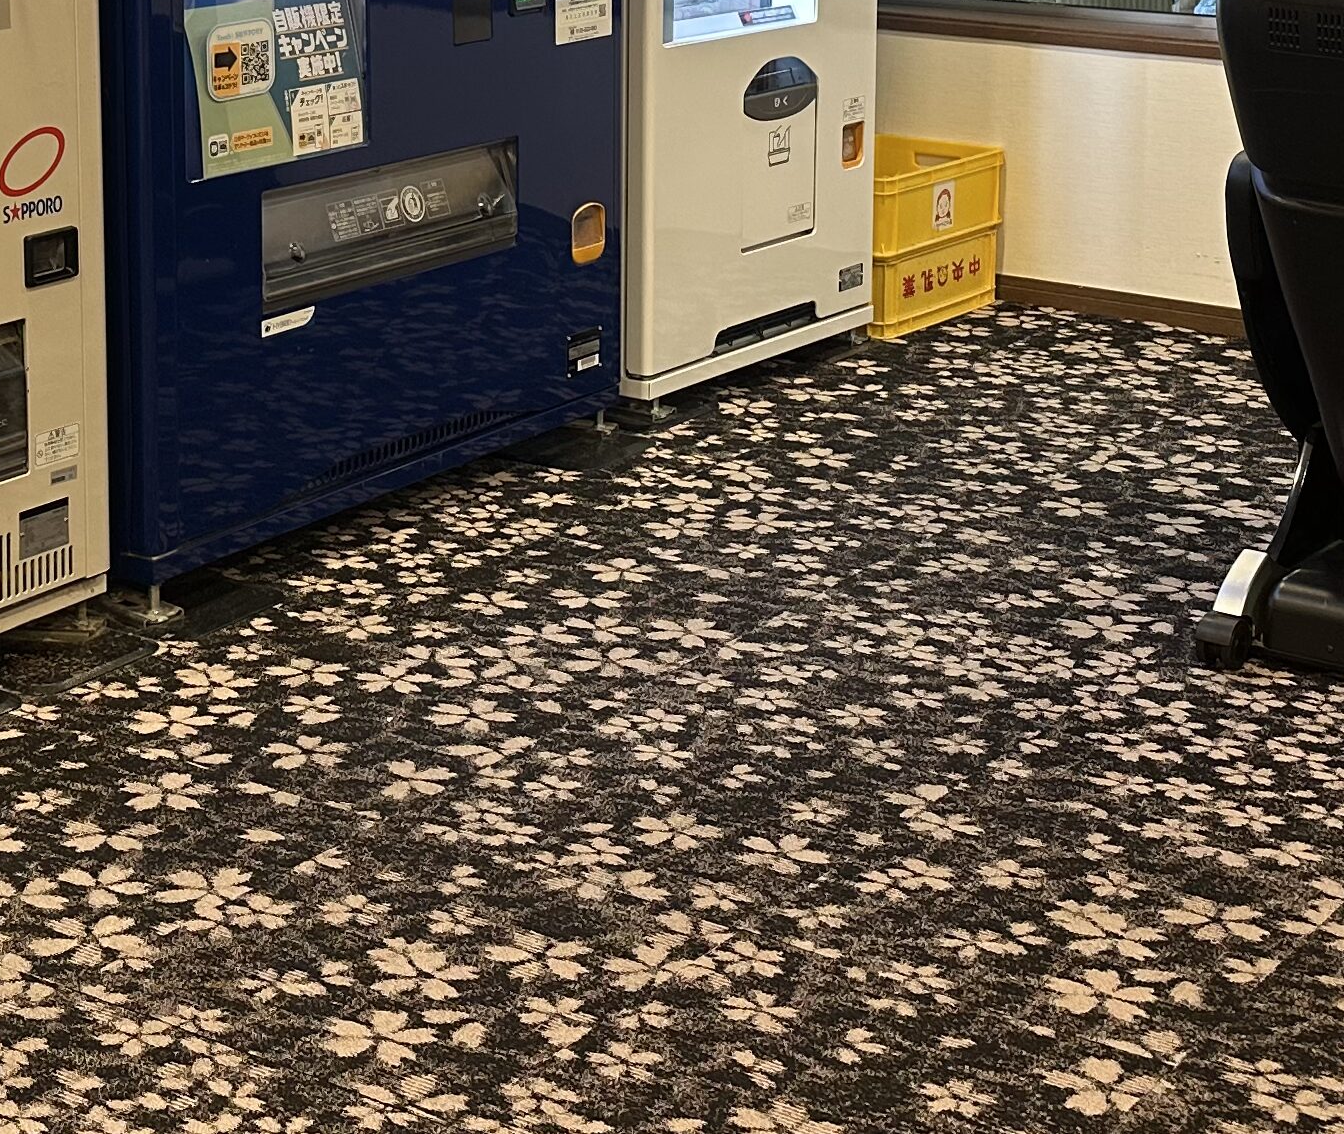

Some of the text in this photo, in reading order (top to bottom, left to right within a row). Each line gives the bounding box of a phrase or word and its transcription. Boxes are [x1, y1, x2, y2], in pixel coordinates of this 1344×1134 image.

[272, 1, 344, 32] 自販機限定
[278, 28, 347, 58] キャンペーン
